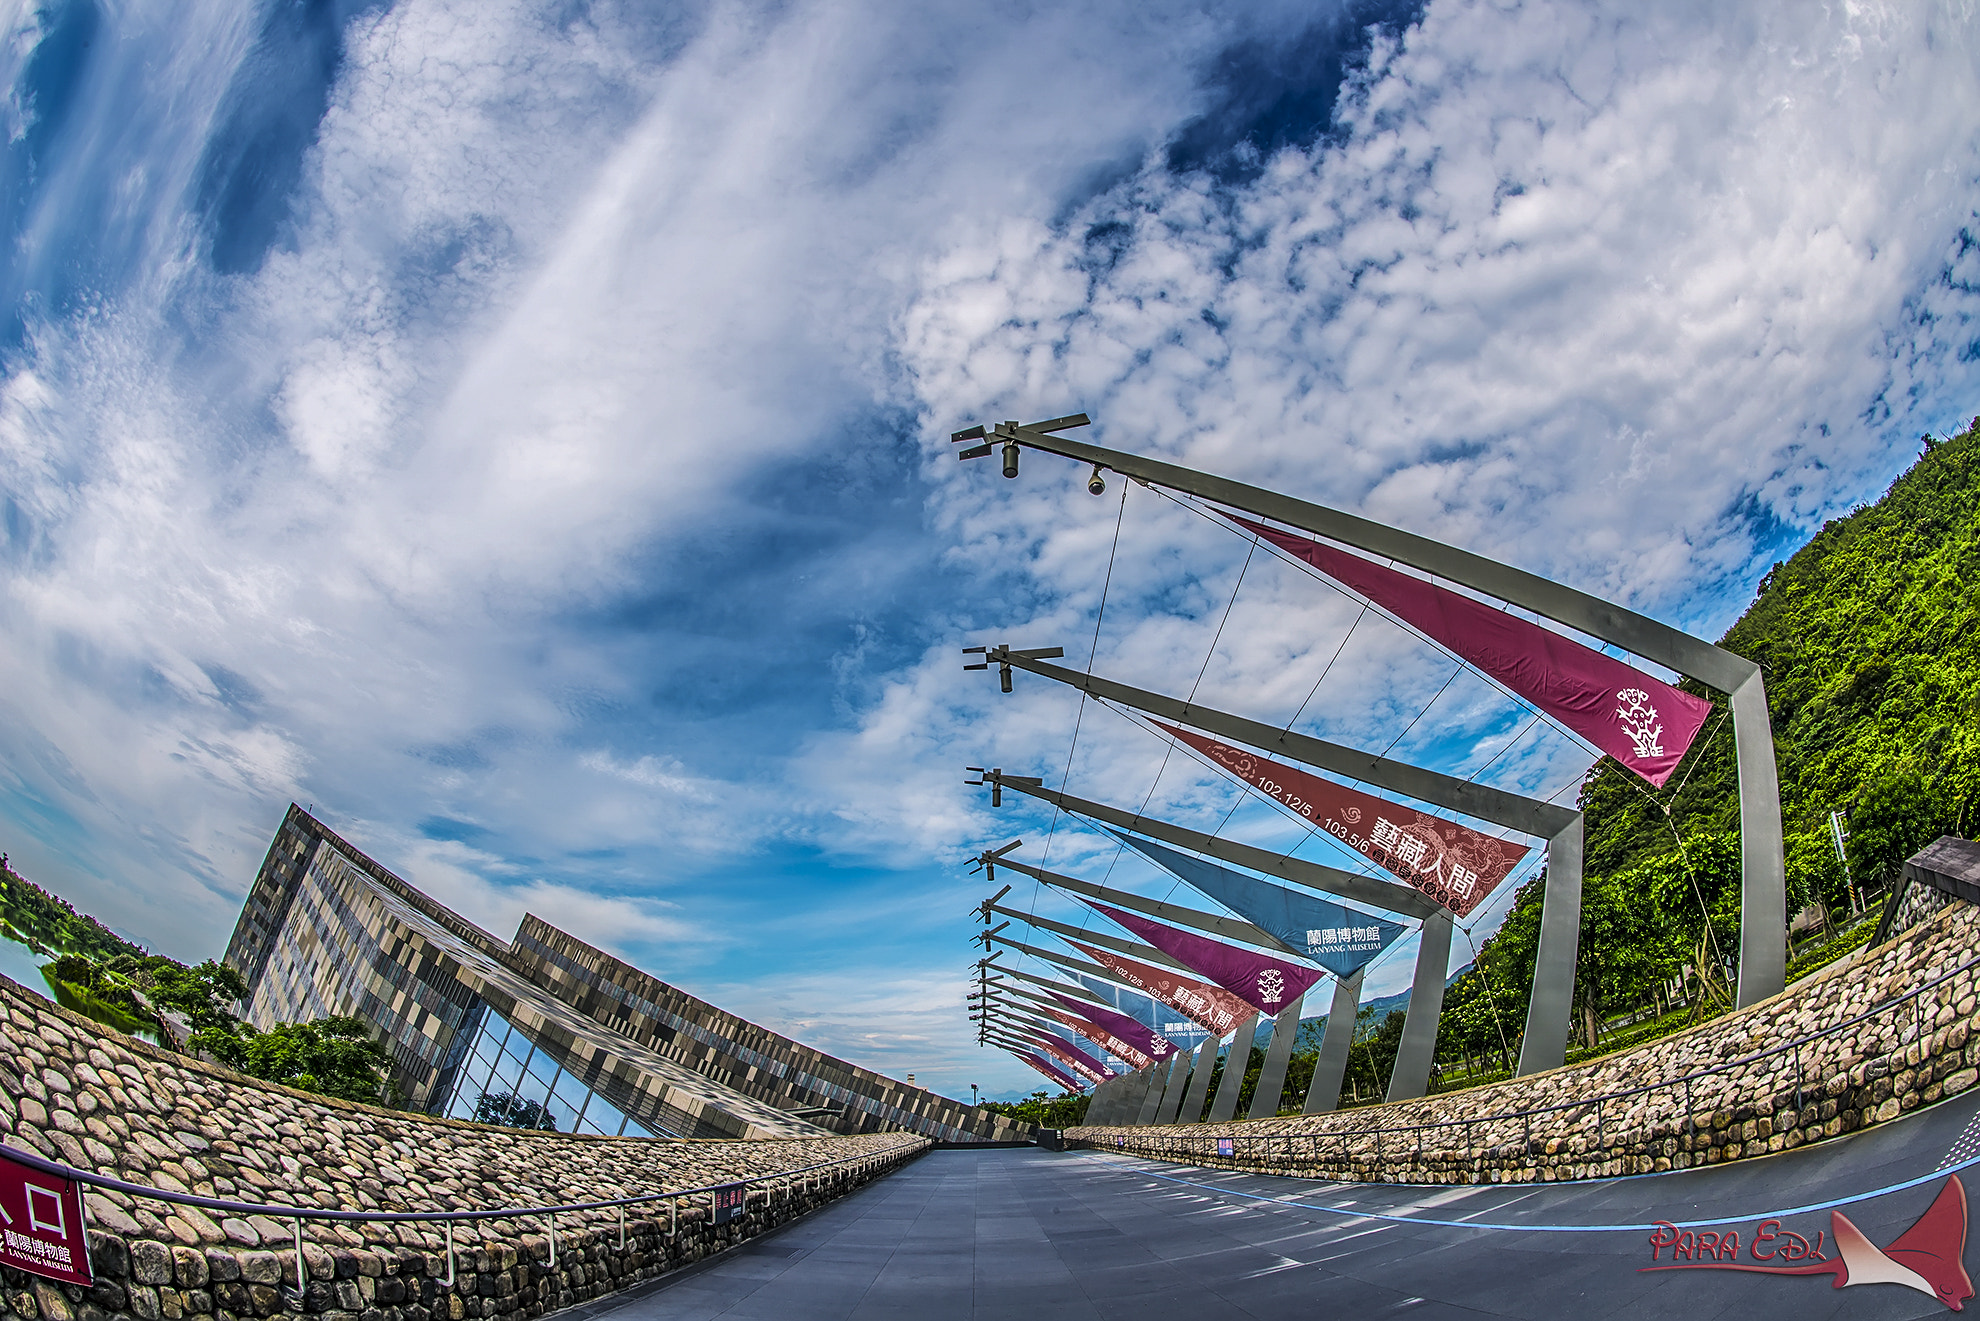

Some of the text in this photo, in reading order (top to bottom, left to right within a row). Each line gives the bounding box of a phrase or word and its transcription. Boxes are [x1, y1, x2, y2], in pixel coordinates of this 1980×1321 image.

[1258, 776, 1371, 853] 102.12/5 103.5/6
[1369, 816, 1478, 900] 藝藏人間
[1306, 926, 1380, 946] 蘭陽博物館
[1308, 942, 1382, 954] LANYANG MUSEUM
[1114, 965, 1172, 1005] 102.12/5 103.5/6
[1172, 985, 1234, 1029] 藝藏人間
[4, 1228, 72, 1264] 蘭陽博物館
[8, 1248, 74, 1273] LANYANG MUSEUM
